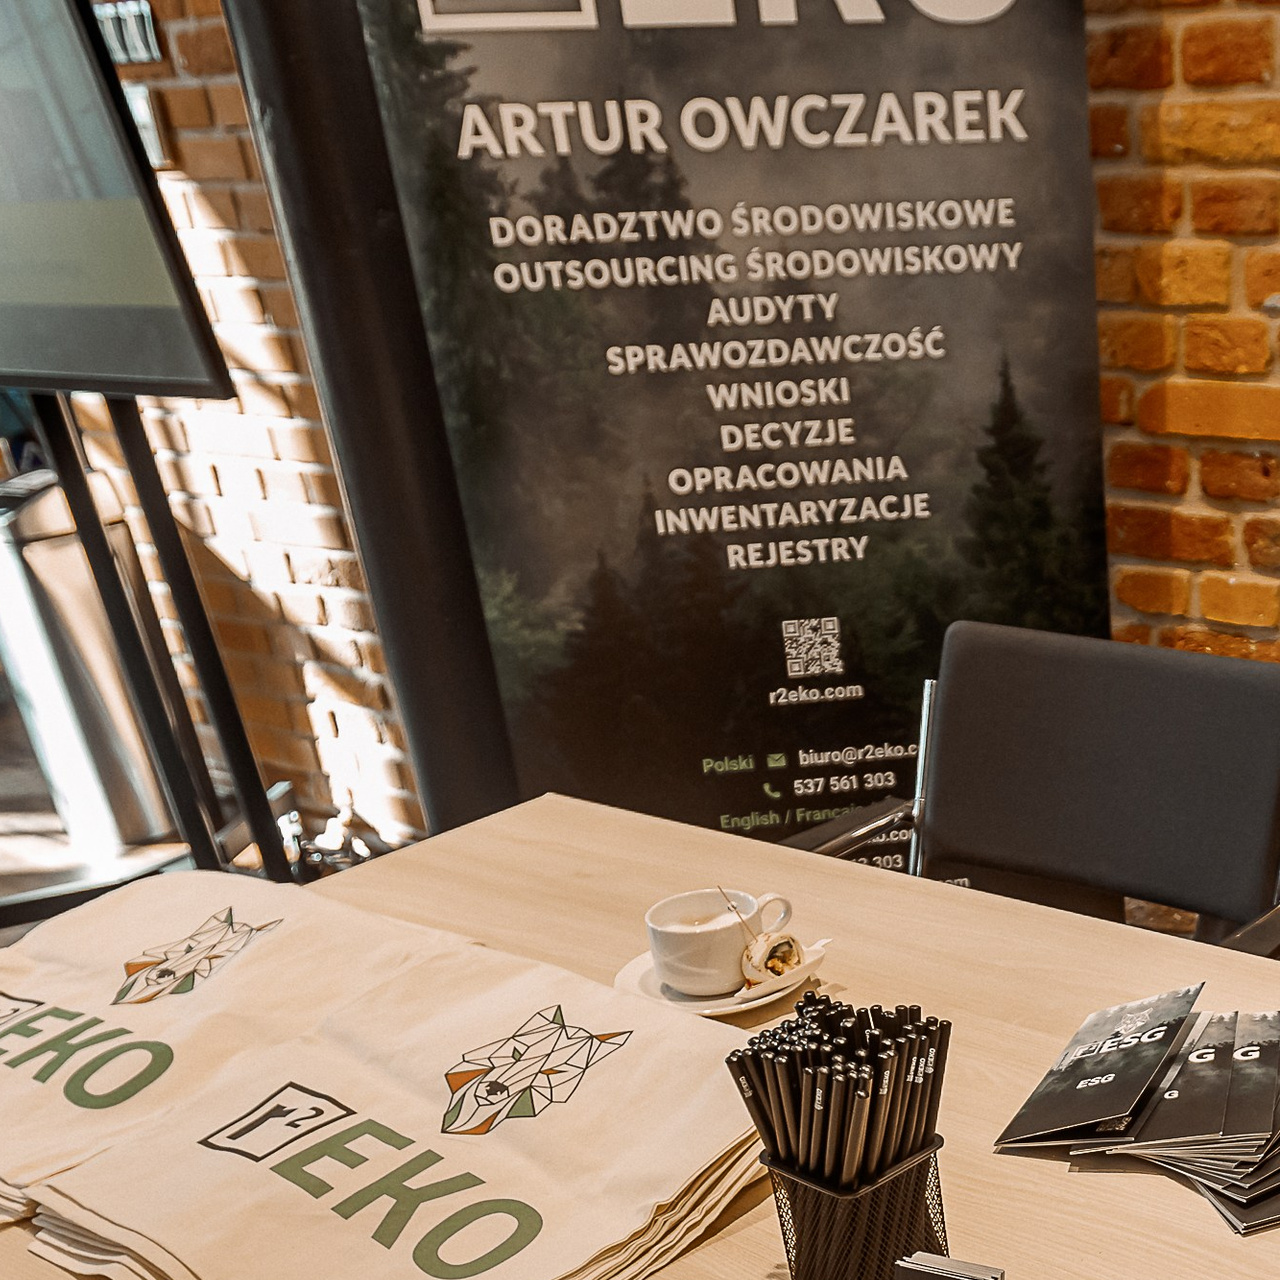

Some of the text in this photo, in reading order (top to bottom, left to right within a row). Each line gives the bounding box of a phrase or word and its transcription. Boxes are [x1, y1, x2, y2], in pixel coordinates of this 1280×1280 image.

[457, 90, 1029, 158] ARTUR OWCZAREK
[489, 198, 1015, 248] DORADZTWO ŚRODOWISKOWE
[494, 242, 1022, 293] OUTSOURCING ŚRODOWISKOWY
[707, 293, 838, 327] AUDYTY
[606, 326, 945, 374] SPRAWOZDAWCZOŚĆ
[706, 378, 850, 410] WNIOSKI
[721, 418, 855, 450] DECYZJE
[668, 456, 907, 494] OPRACOWANIA
[655, 494, 931, 535] INWENTARYZACJE
[727, 537, 868, 569] REJESTRY
[769, 684, 864, 705] r2eko.com
[702, 755, 754, 773] Polski
[793, 772, 896, 795] 537 561 303
[720, 809, 779, 831] English
[1075, 1073, 1116, 1090] ESG
